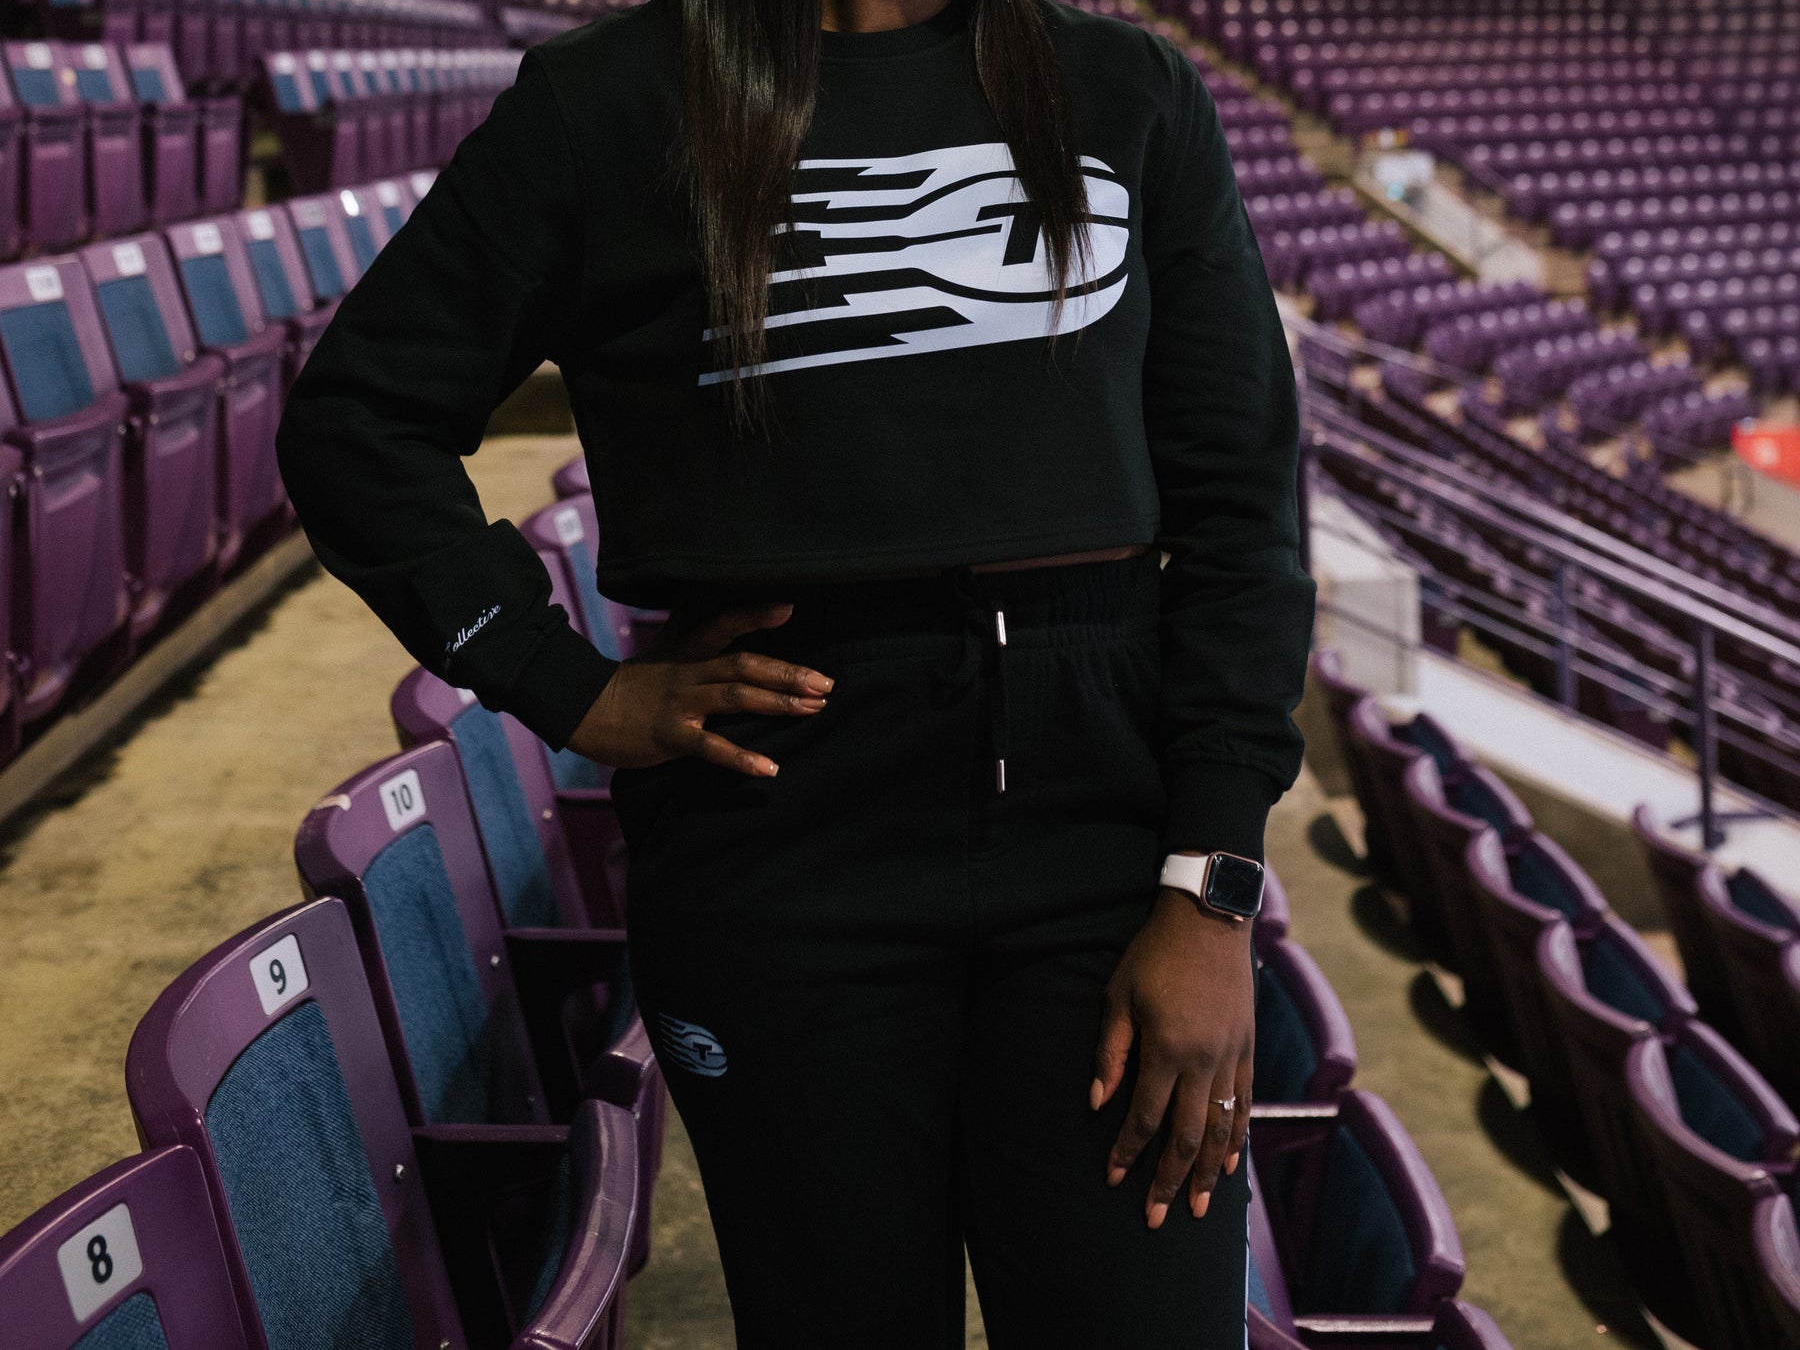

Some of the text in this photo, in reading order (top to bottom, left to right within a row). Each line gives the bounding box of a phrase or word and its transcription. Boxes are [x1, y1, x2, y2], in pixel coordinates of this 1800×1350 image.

[391, 783, 413, 816] 10
[269, 958, 287, 996] 9
[86, 1234, 114, 1284] 8
